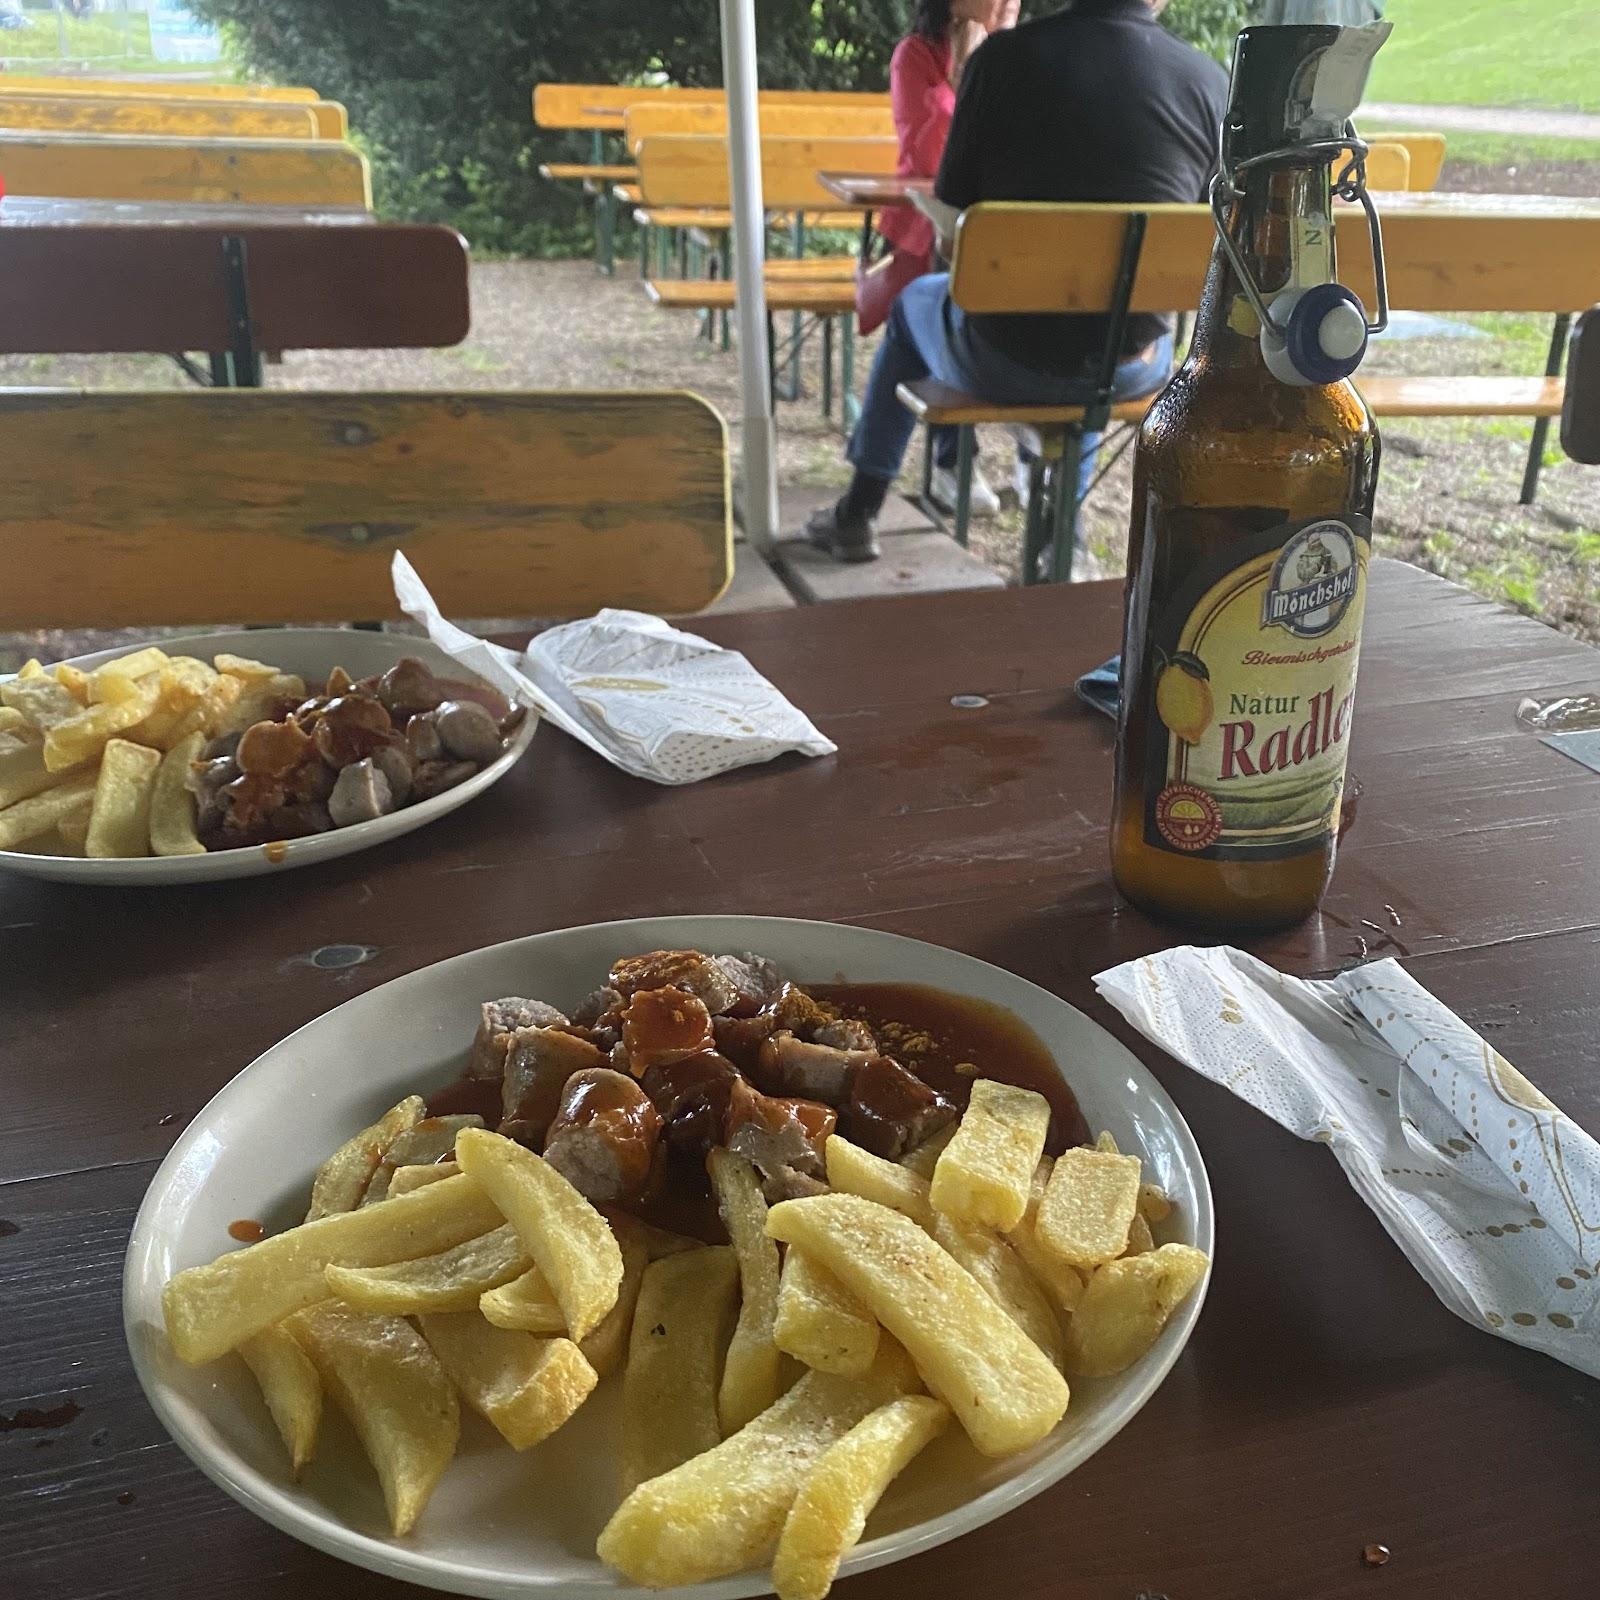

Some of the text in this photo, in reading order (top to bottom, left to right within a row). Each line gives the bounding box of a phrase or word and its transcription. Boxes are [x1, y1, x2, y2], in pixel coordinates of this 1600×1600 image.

[1272, 566, 1354, 619] Mönchshof
[1229, 693, 1300, 715] Natur
[1216, 684, 1354, 783] Radle
